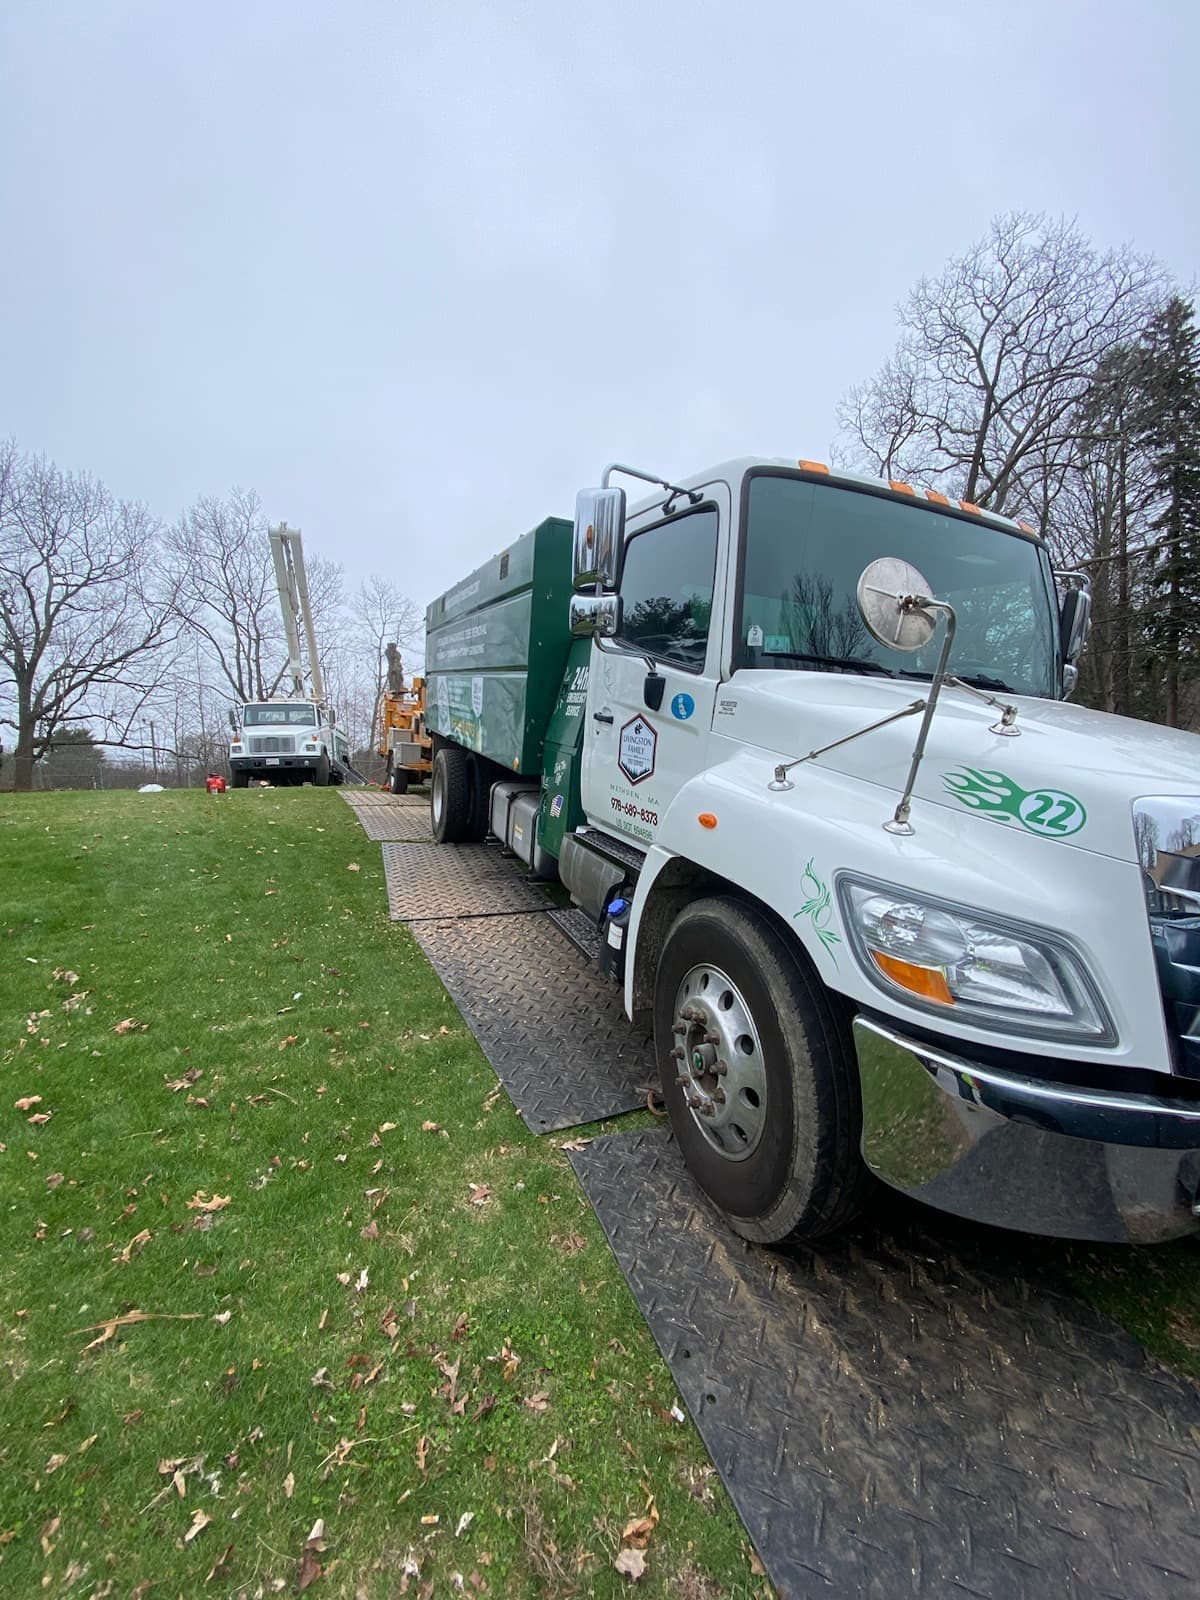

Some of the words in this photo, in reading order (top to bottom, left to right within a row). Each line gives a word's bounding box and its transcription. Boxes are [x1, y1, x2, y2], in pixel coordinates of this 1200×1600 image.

[570, 666, 590, 690] 24h
[623, 735, 652, 747] LIVINGSTON
[627, 743, 644, 755] FAMILY
[647, 796, 660, 806] MA
[610, 797, 658, 826] 978-689-8373
[1025, 794, 1076, 832] 22
[615, 817, 623, 828] US
